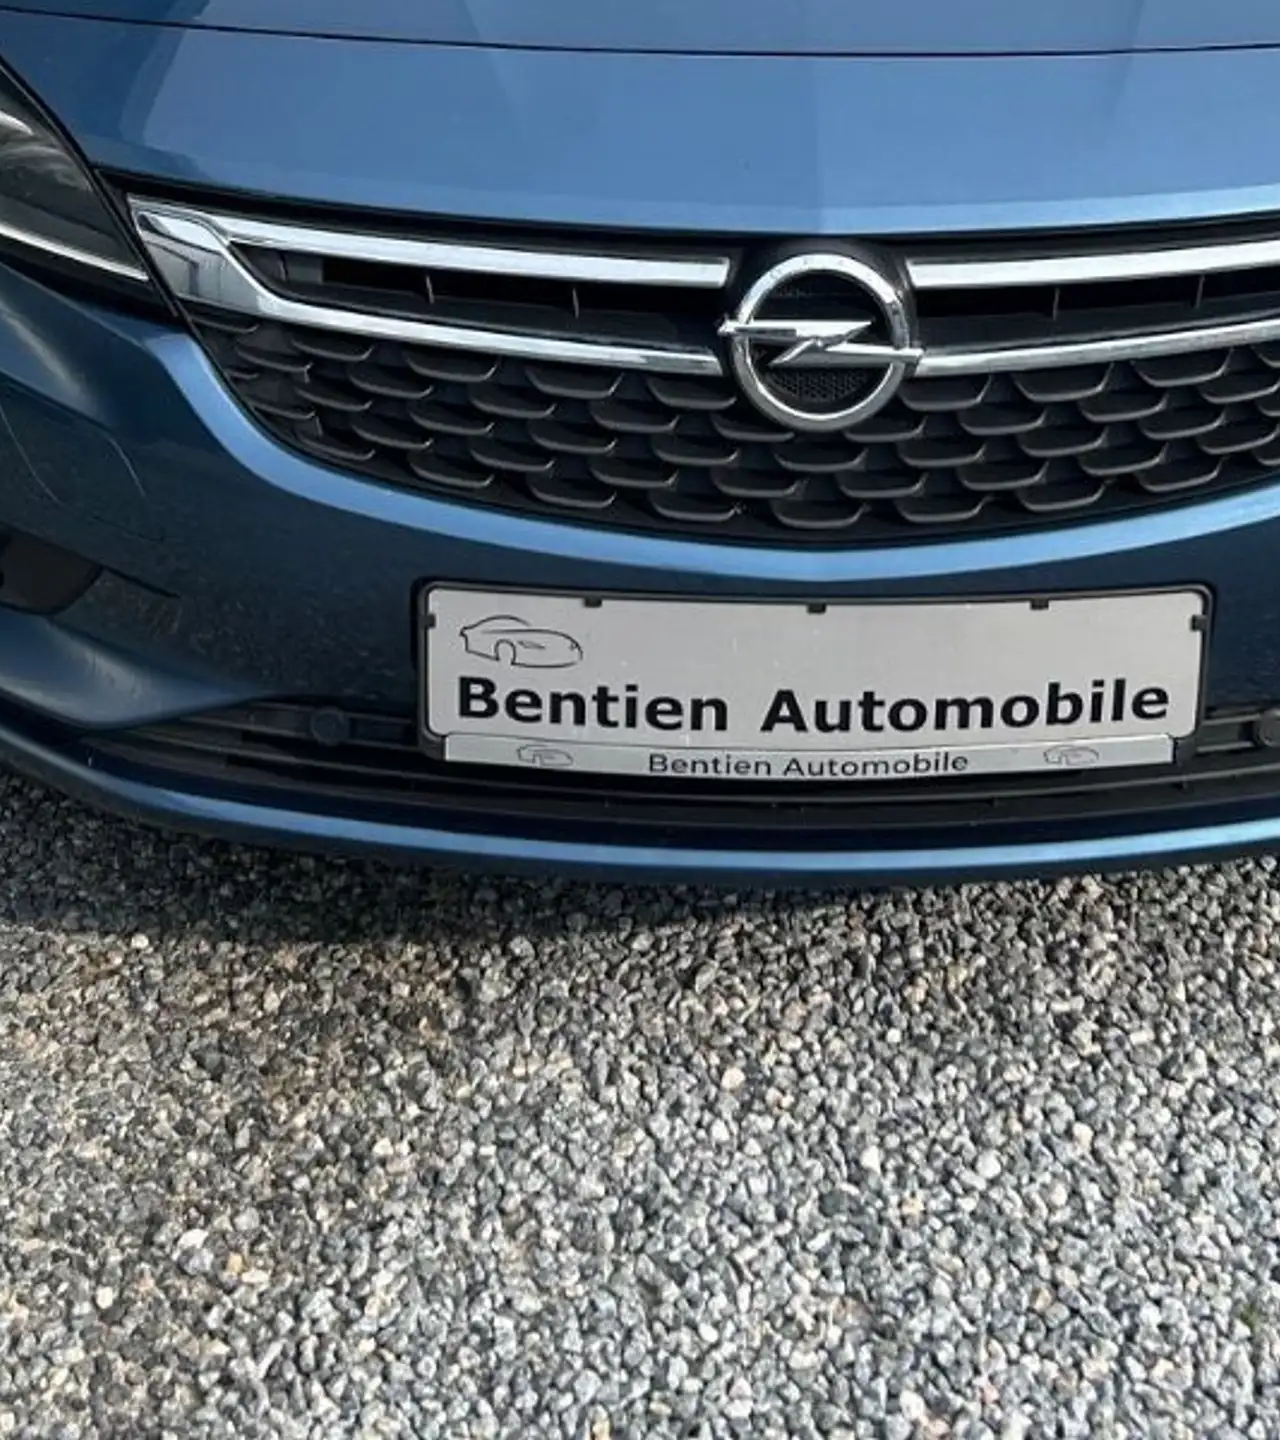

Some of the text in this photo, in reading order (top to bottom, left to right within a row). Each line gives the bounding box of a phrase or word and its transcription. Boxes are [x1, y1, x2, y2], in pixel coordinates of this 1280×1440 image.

[458, 676, 1170, 734] Bentien Automobile
[648, 751, 969, 777] Bentien Automobile
